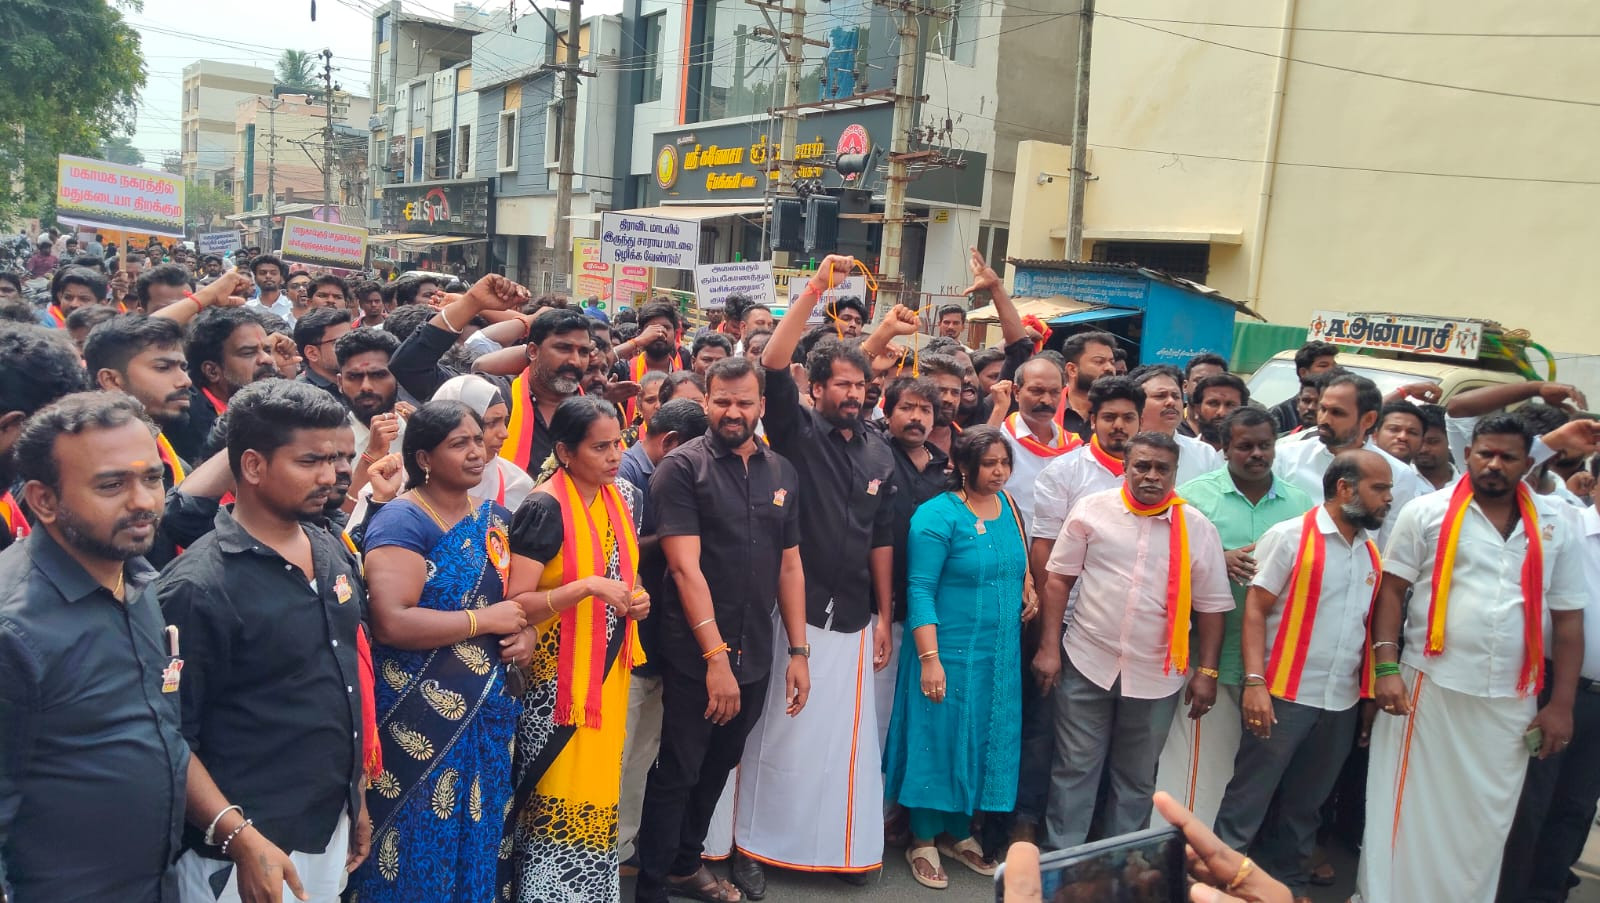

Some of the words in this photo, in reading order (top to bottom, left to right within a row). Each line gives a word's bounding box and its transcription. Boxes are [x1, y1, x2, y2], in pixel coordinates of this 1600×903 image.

[70, 167, 117, 184] மகாமக
[120, 175, 174, 194] நகரத்தில்
[60, 186, 131, 207] மதுகடையா
[620, 219, 648, 232] திராவிட
[650, 223, 680, 235] மாடலில்
[604, 231, 636, 248] இருந்து
[637, 238, 663, 248] சாராய
[664, 241, 693, 251] மாடலை
[615, 249, 642, 262] ஒழிக்க
[644, 250, 682, 265] வேண்டும்!
[1325, 317, 1454, 351] A.அன்பரசி
